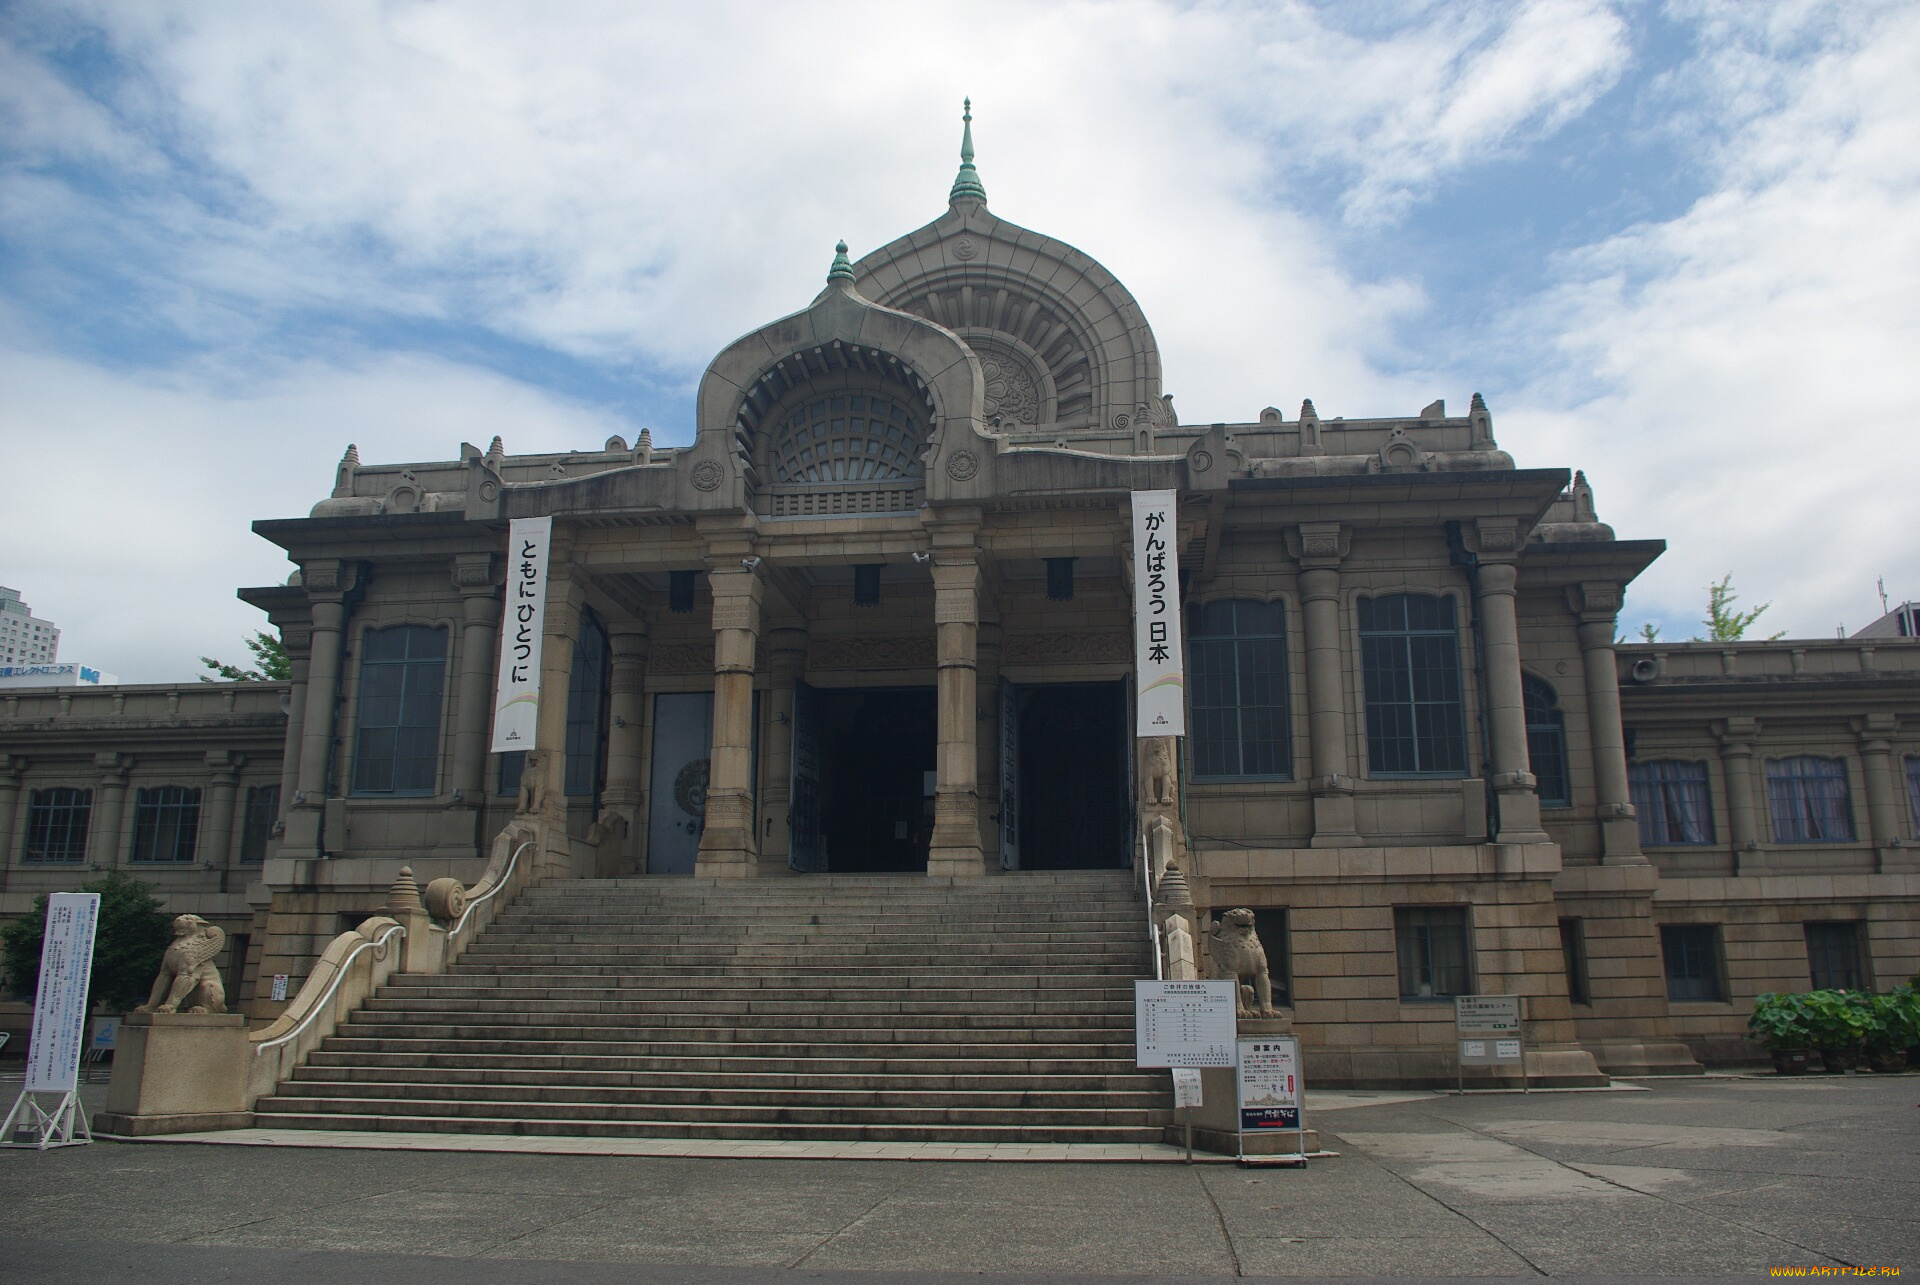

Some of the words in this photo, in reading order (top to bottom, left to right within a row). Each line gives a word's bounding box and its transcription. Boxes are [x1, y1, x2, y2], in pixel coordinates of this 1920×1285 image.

[0, 666, 74, 677] 日エレクトロニクス
